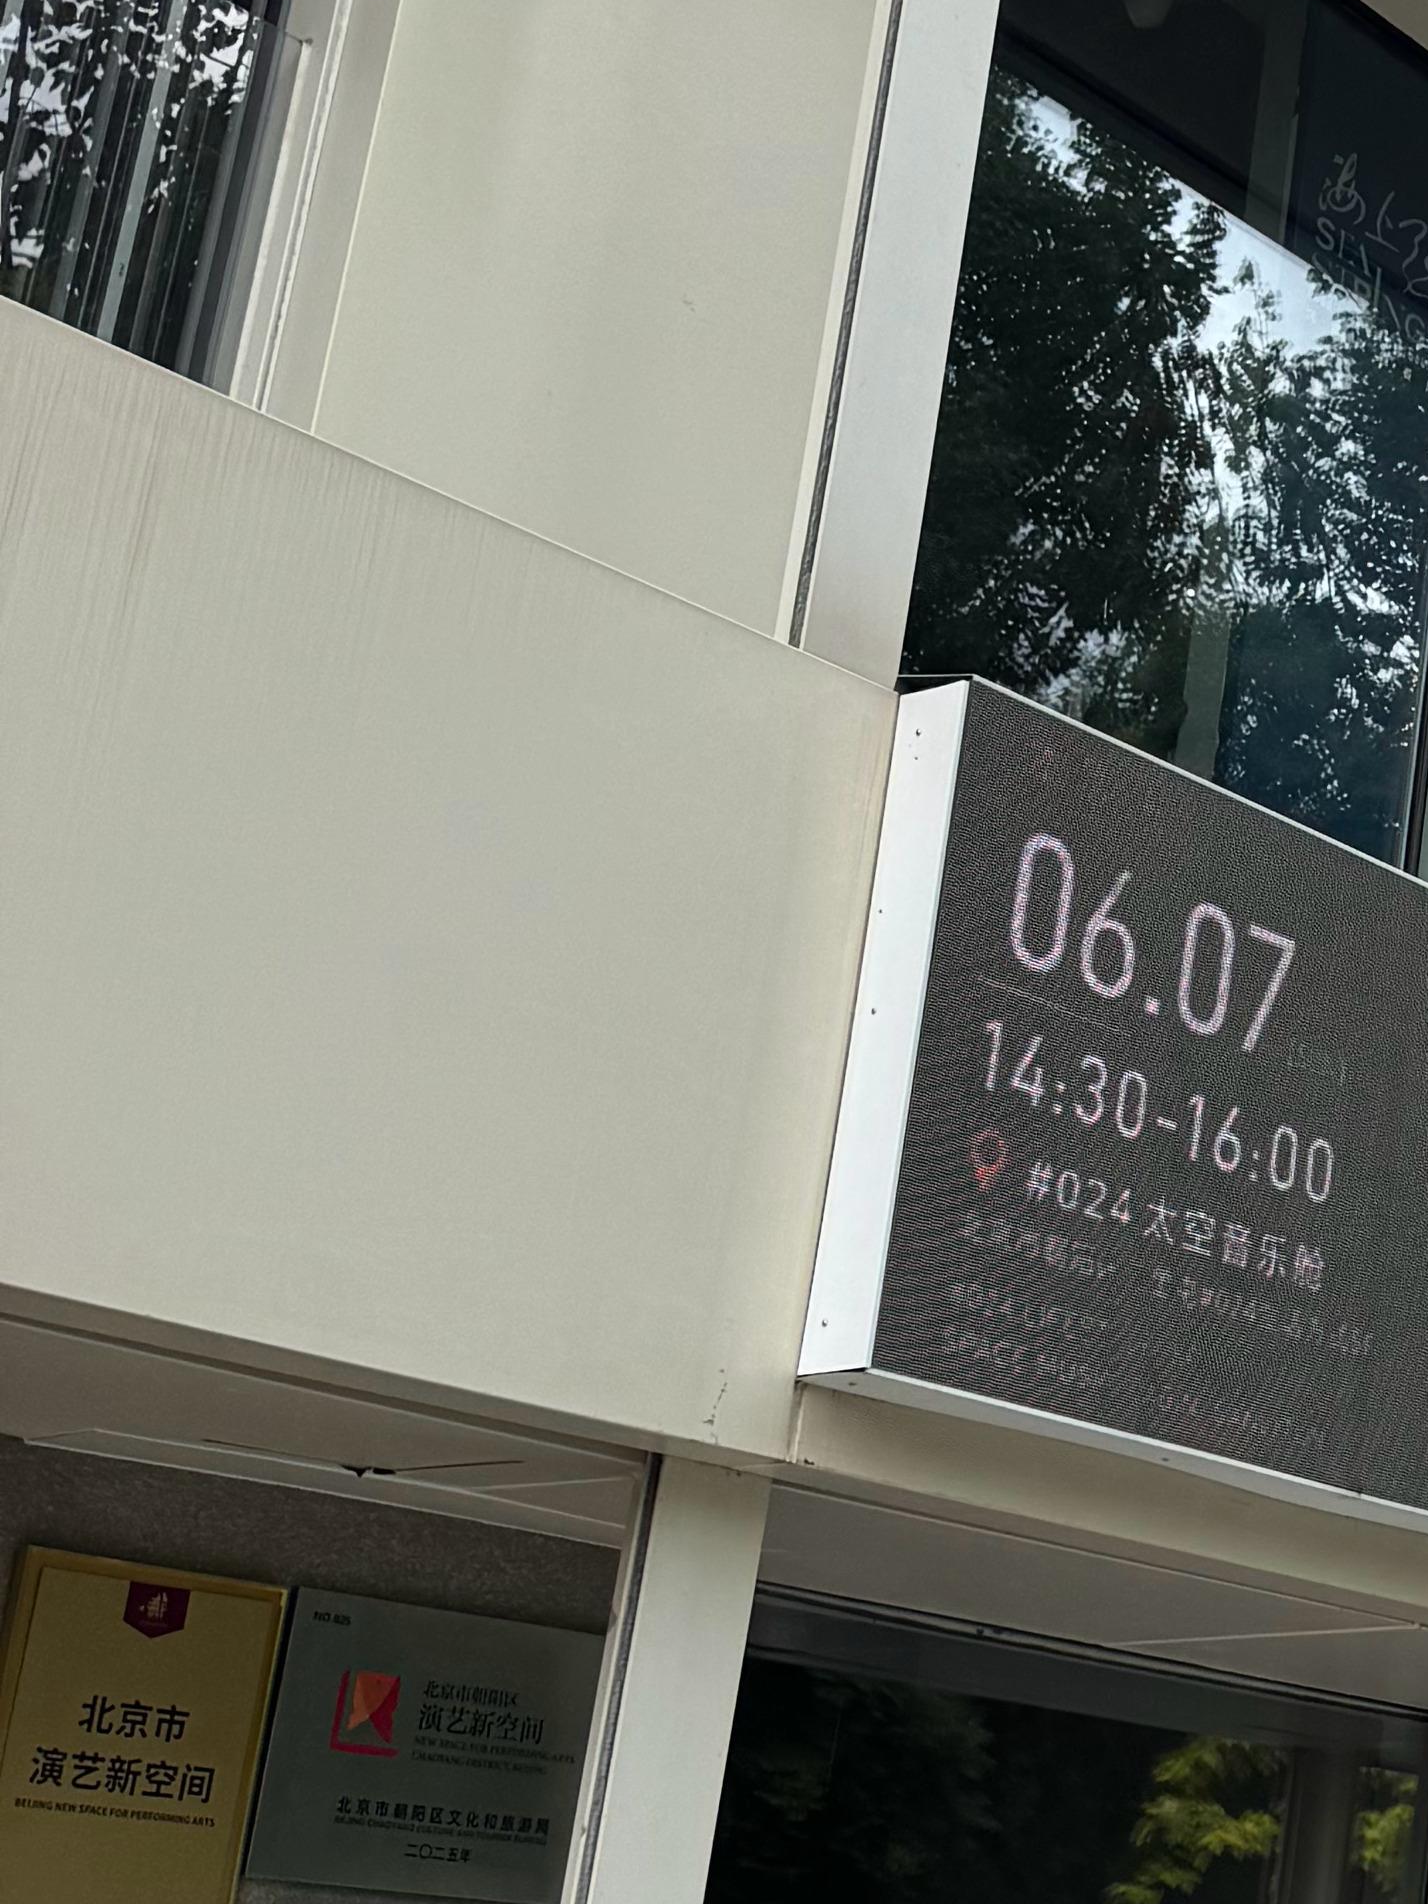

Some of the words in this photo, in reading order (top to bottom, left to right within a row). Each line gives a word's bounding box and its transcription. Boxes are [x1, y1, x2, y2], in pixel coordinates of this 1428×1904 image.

[1010, 833, 1297, 1053] 06.07
[980, 1019, 1336, 1203] 14:30-16:00
[1025, 1162, 1131, 1223] #024
[78, 1695, 190, 1743] 北京市
[418, 1703, 544, 1744] 演艺新空间
[29, 1746, 215, 1804] 演艺新空间
[15, 1798, 52, 1811] BEIJING
[55, 1802, 77, 1814] NEW
[79, 1804, 108, 1817] SPACE
[109, 1807, 129, 1819] FOR
[130, 1809, 190, 1825] PERFORMING
[192, 1814, 215, 1828] ARTS
[336, 1794, 550, 1836] 北京市朝阳区文化和旅游局
